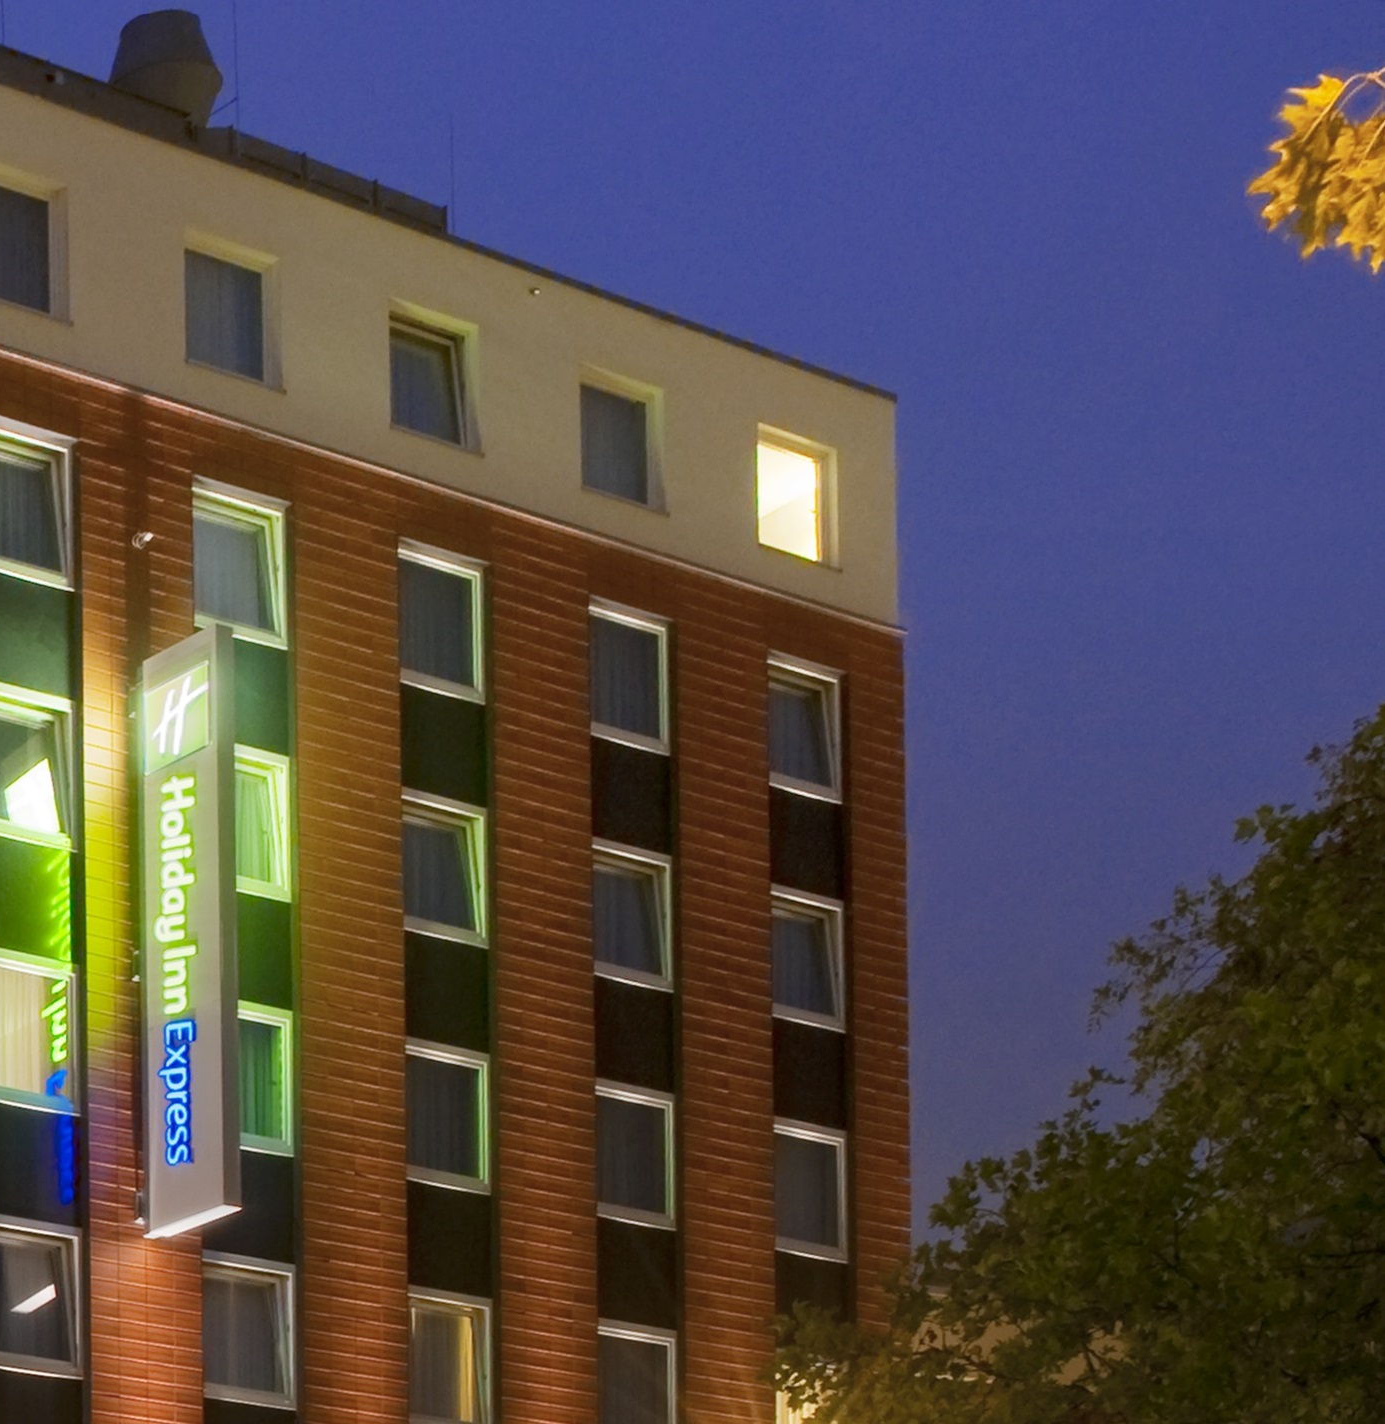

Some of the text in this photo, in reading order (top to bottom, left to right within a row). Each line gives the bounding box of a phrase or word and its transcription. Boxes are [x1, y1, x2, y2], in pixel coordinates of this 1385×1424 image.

[154, 776, 197, 1166] Holiday Inn Express
